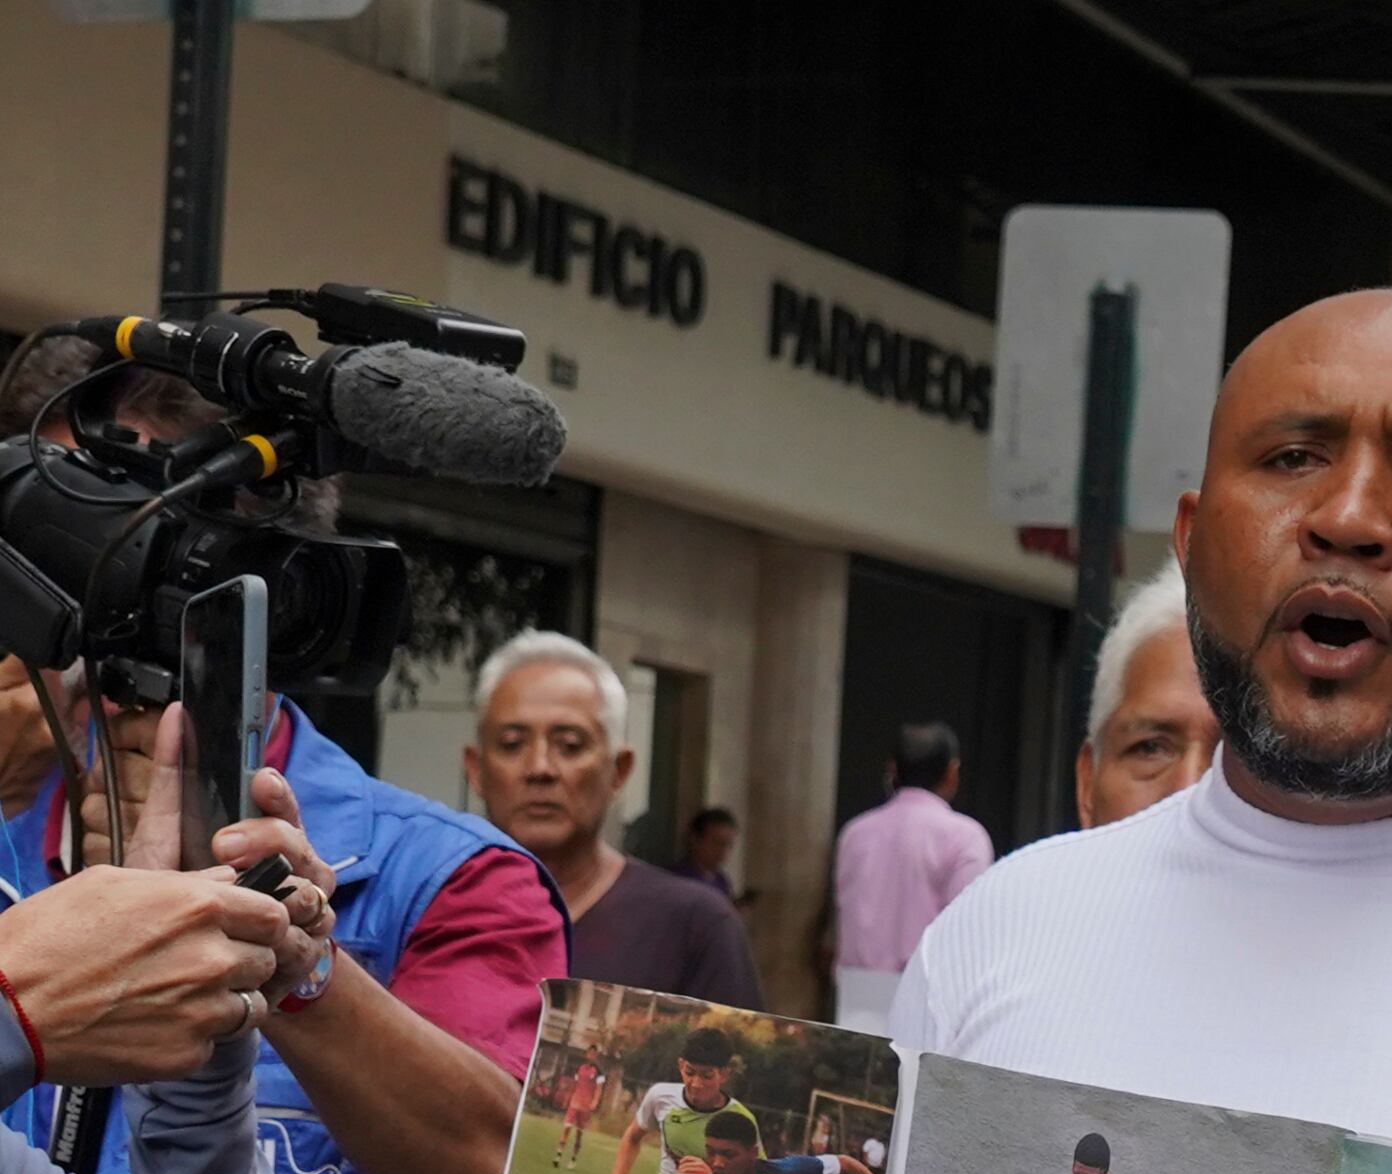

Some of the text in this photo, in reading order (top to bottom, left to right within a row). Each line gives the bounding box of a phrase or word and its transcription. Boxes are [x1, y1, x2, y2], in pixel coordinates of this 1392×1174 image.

[445, 153, 706, 327] EDIFICIO
[767, 279, 995, 434] PARQUEOS
[55, 1086, 87, 1164] Manfro
